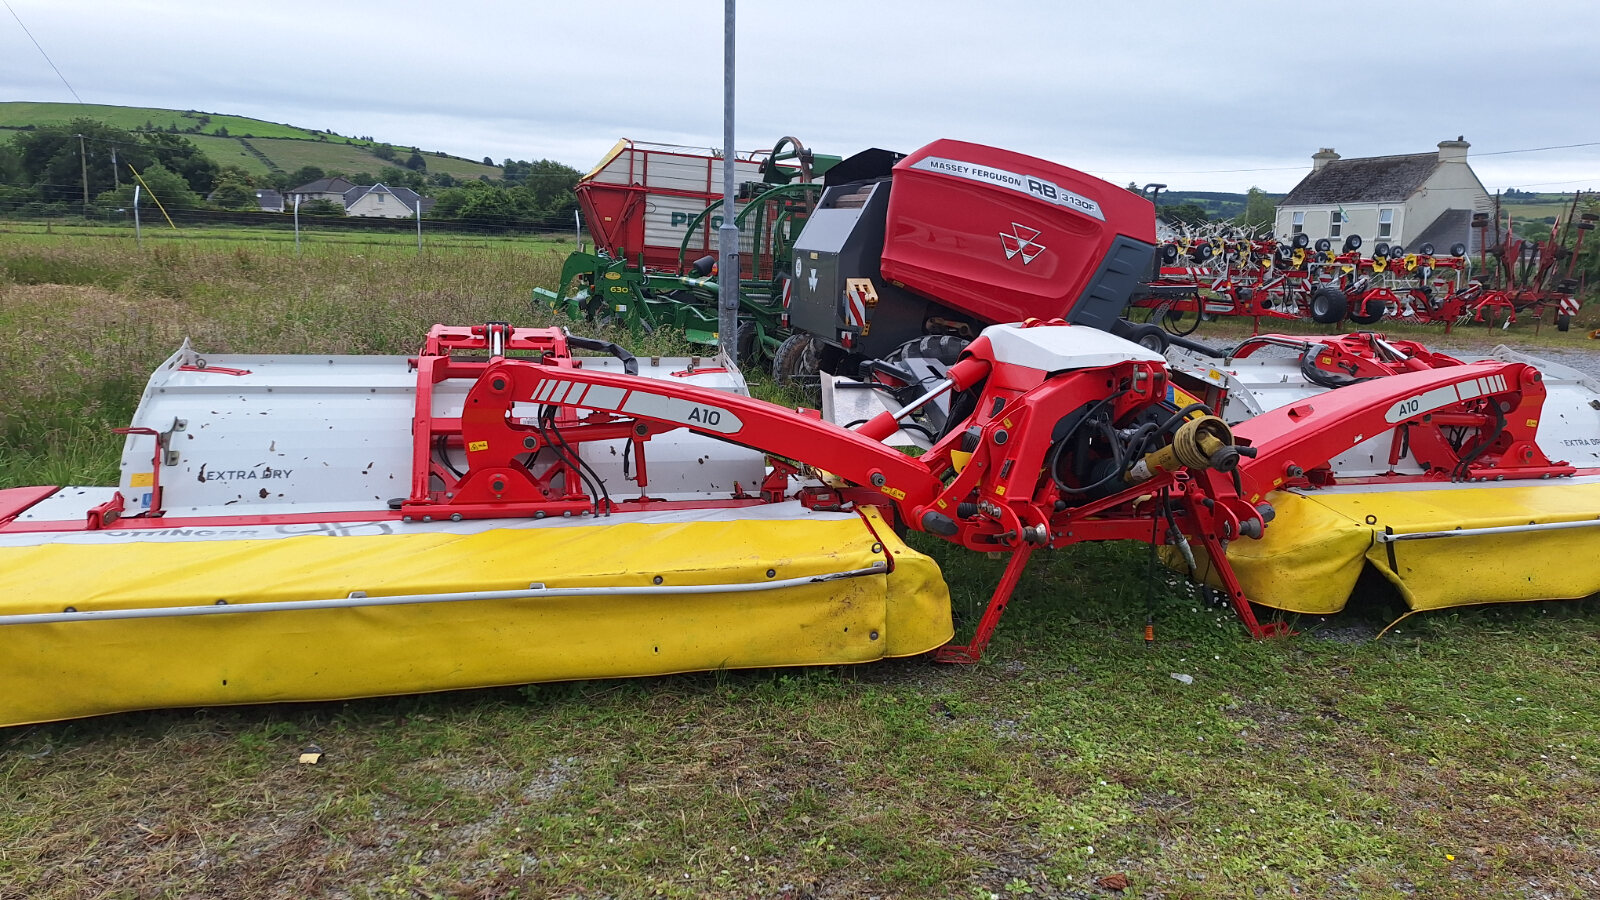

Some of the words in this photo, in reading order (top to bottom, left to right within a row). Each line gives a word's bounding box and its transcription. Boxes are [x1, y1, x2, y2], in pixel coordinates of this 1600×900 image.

[930, 160, 969, 174] MASSEY
[971, 168, 1021, 187] FERGUSON
[1027, 179, 1057, 200] RB
[1061, 193, 1095, 212] 3130F
[688, 407, 721, 426] A10
[1398, 399, 1419, 417] A10
[1563, 439, 1591, 447] EXTRA
[206, 470, 257, 481] EXTRA
[262, 469, 293, 480] DRY
